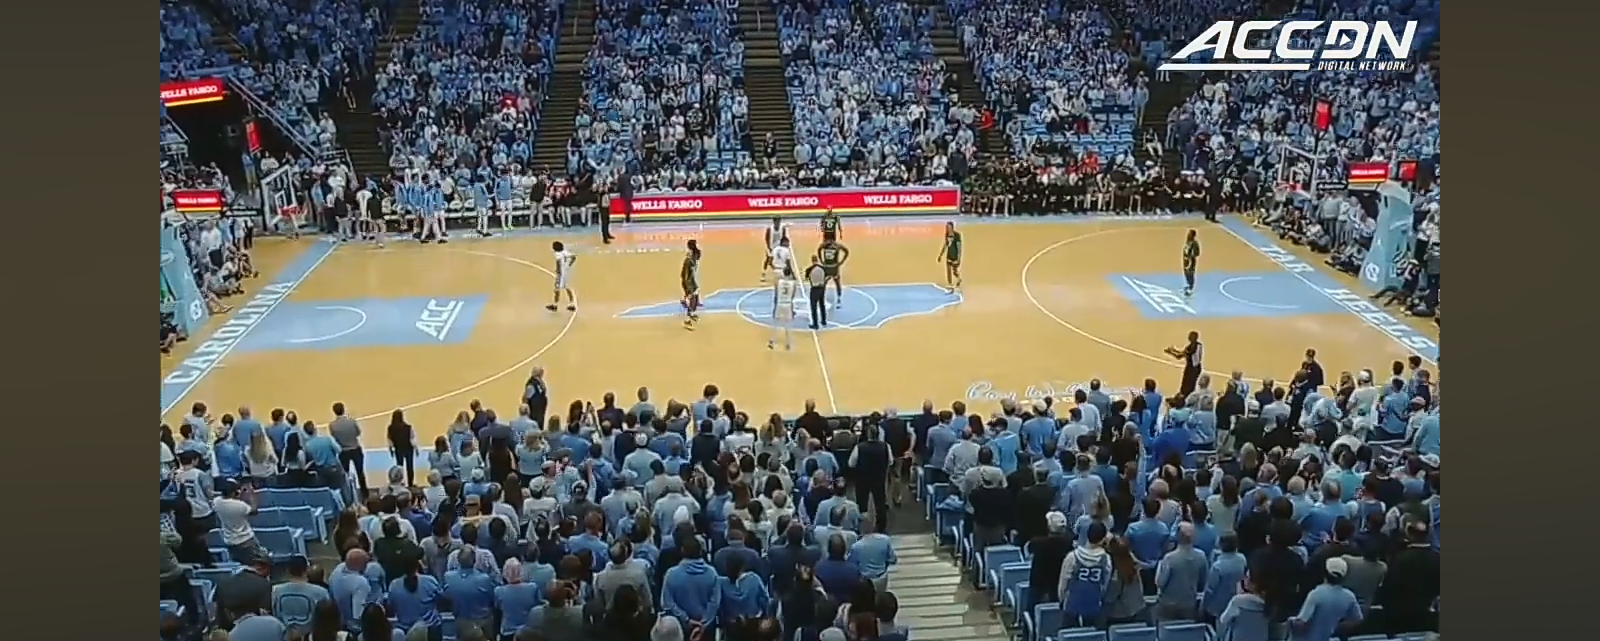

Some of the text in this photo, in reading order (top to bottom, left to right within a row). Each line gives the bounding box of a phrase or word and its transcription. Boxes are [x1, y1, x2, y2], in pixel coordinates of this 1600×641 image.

[632, 199, 703, 210] WELLS FARGO
[748, 195, 819, 207] WELLS FARGO
[863, 194, 933, 204] WELLS FARGO
[1260, 243, 1436, 349] TAR HEELS
[415, 298, 458, 337] ACC
[163, 280, 293, 385] CAROLINA
[1079, 567, 1102, 582] 23
